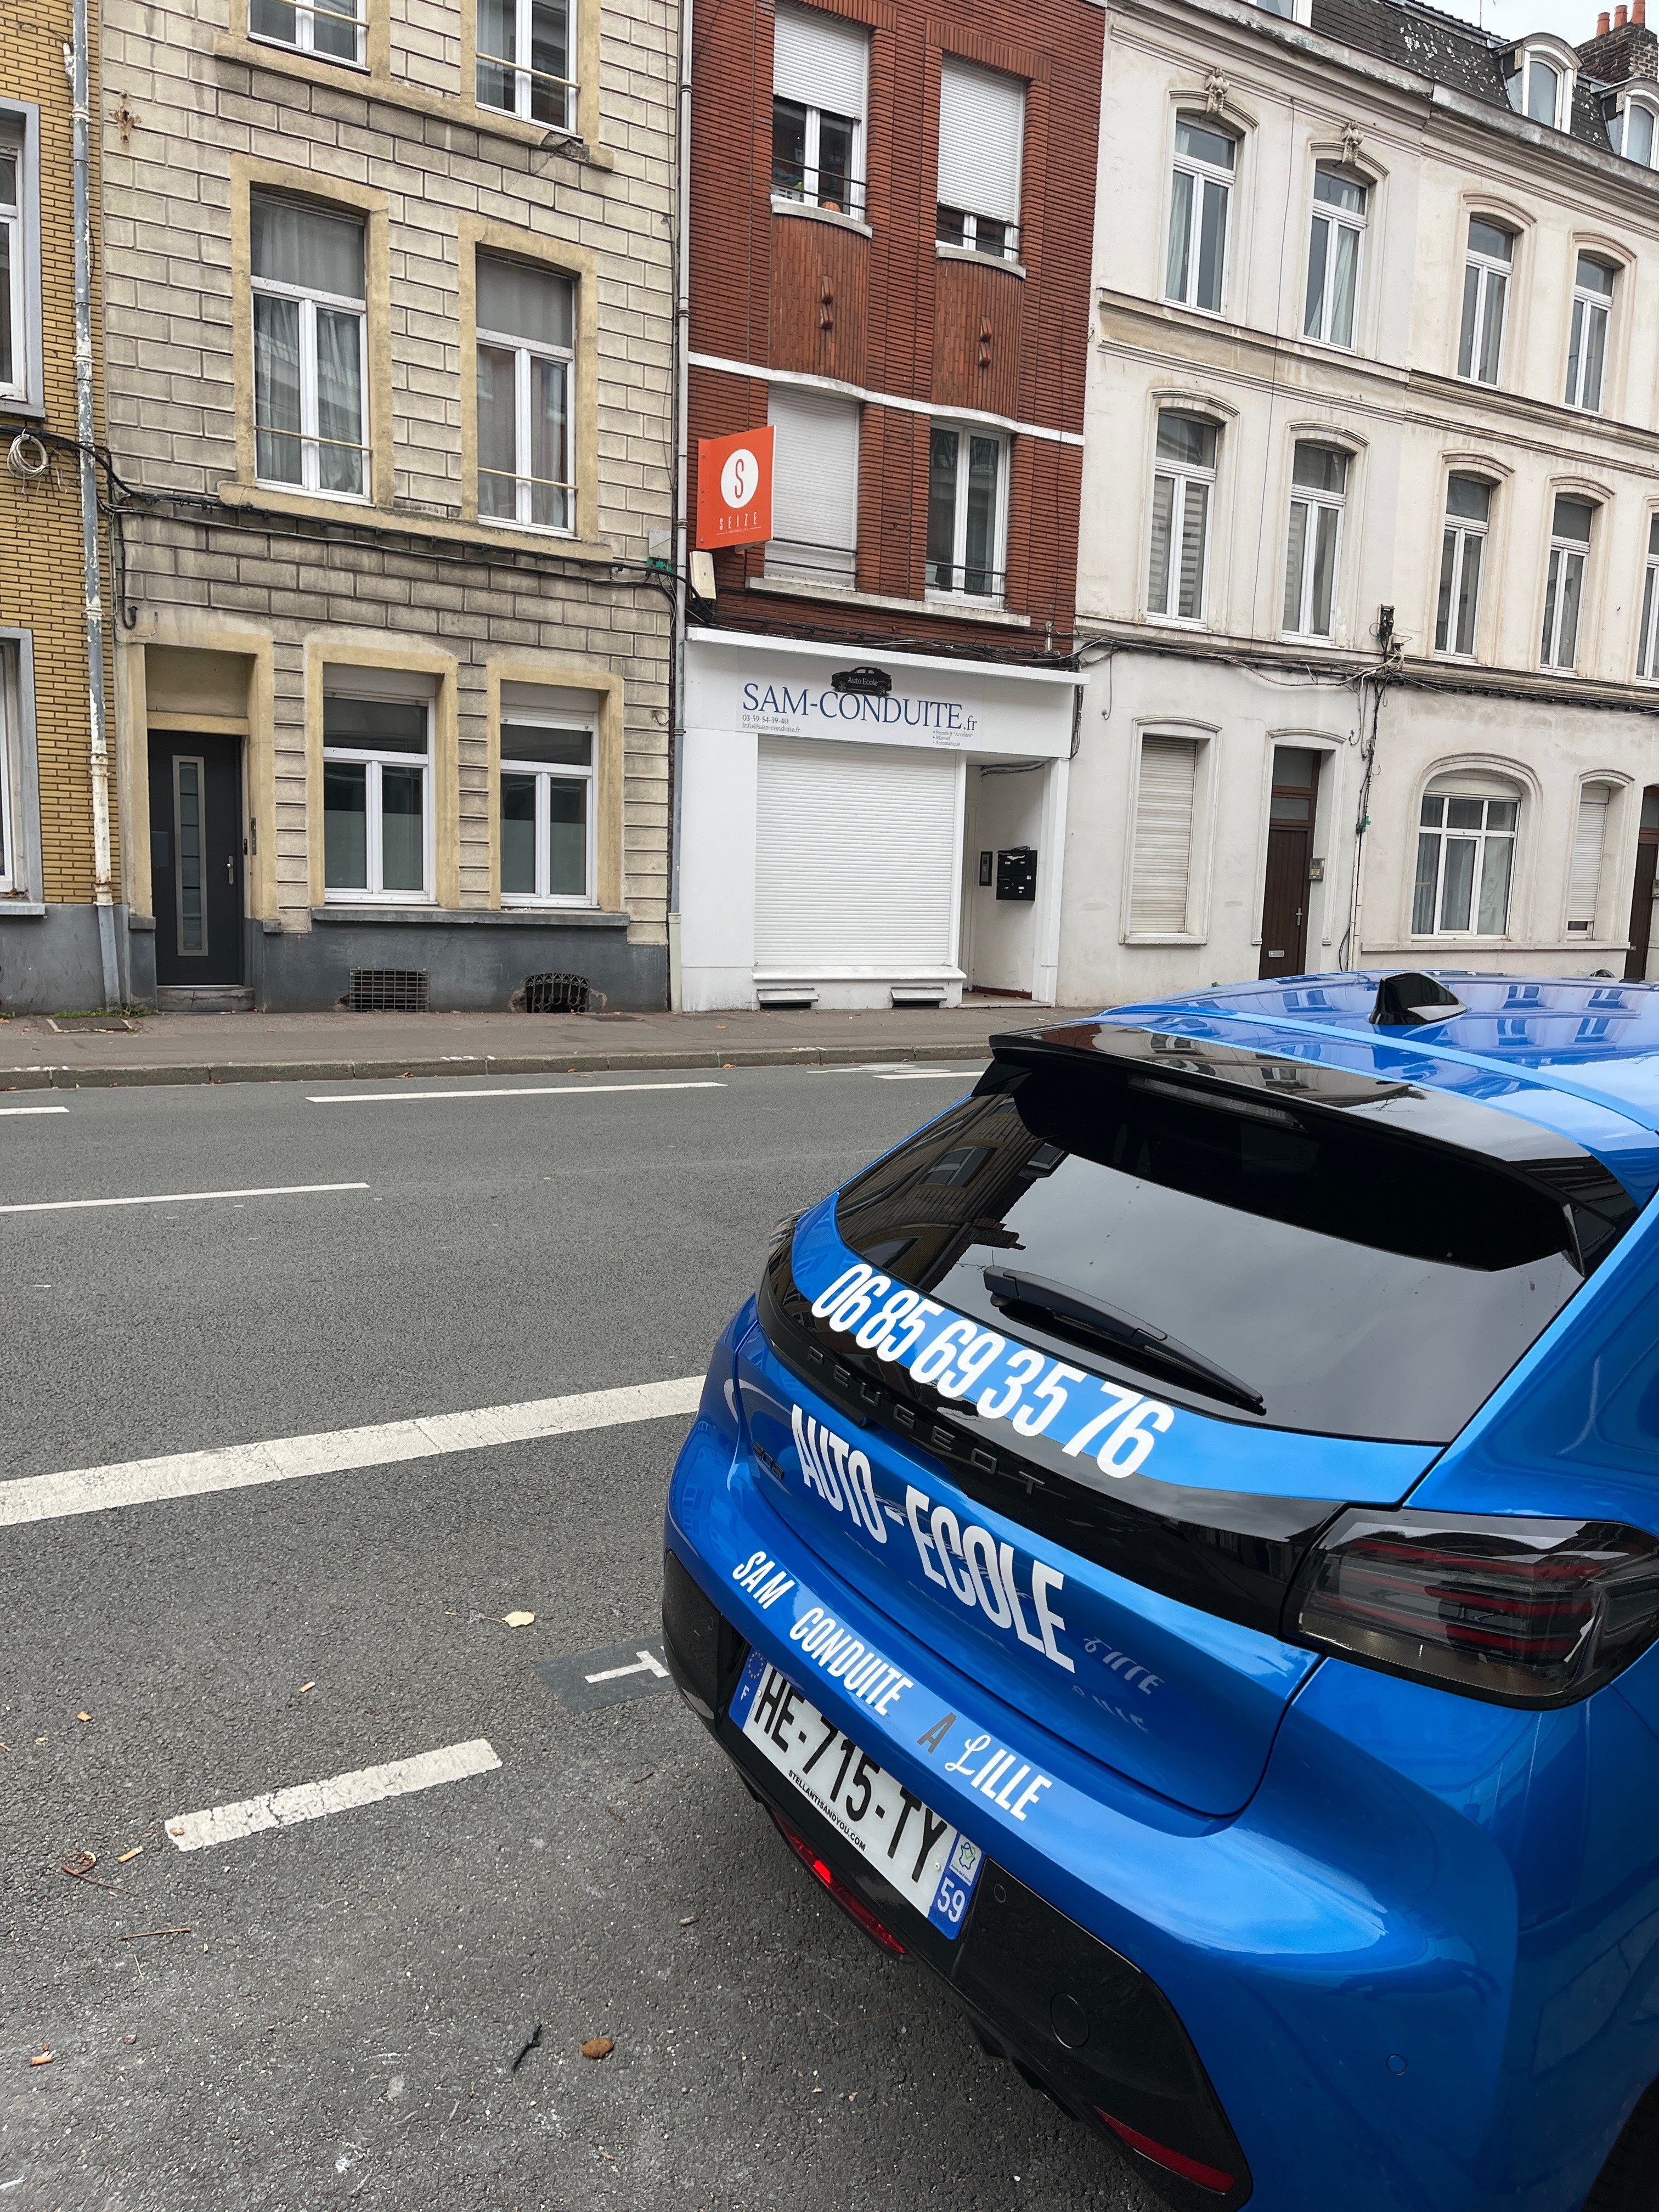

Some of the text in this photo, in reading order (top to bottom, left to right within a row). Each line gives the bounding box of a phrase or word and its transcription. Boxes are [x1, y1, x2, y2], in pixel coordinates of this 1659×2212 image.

[719, 511, 757, 531] SEIZE
[862, 678, 878, 686] Ecole
[742, 714, 789, 724] 03-59-54-39-40
[742, 722, 800, 733] Info@sam-conduite.fr
[743, 683, 977, 731] SAM-CONDUITE.fr
[811, 1263, 1175, 1479] 06 85 69 35 76
[807, 1346, 1046, 1494] PEUGEOT
[791, 1403, 1075, 1673] AUTO-ECOLE
[732, 1551, 1052, 1821] SAM CONDUITE A LILLE
[741, 1685, 750, 1701] F
[754, 1668, 947, 1884] HE-715-TY
[788, 1770, 866, 1852] STELLANTISANDYOU.COM
[937, 1877, 966, 1922] 59
